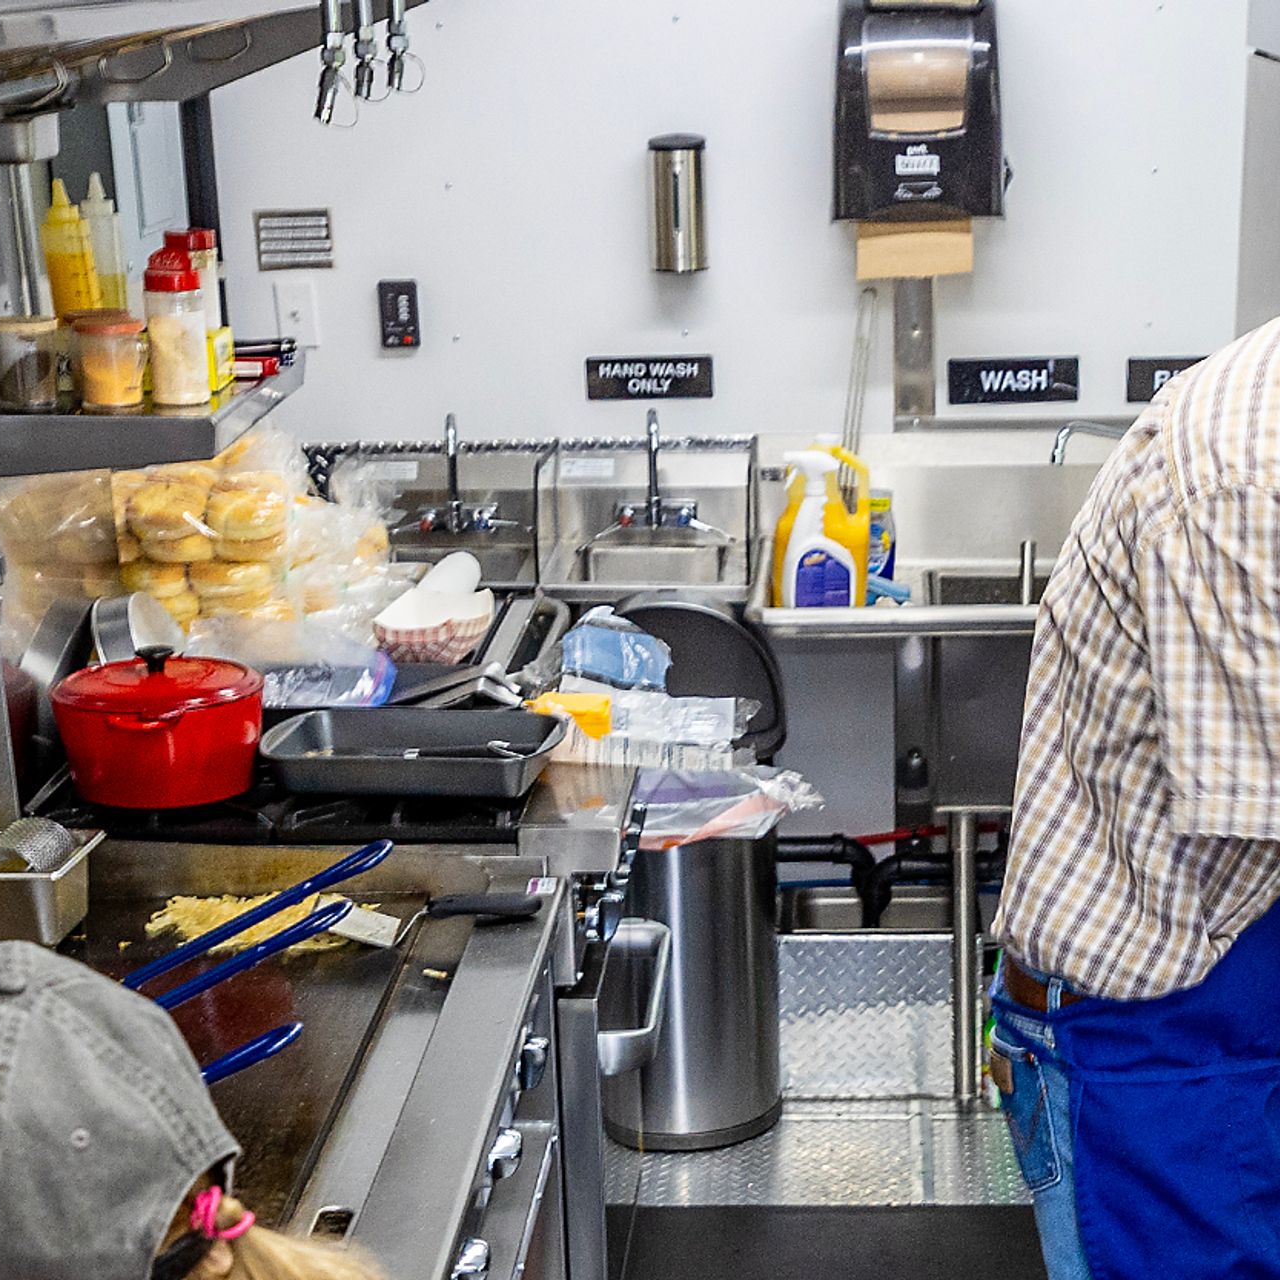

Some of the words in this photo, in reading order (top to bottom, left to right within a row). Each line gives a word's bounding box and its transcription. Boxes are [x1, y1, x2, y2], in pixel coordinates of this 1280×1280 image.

[599, 362, 647, 378] HAND
[649, 362, 699, 378] WASH
[627, 378, 672, 394] ONLY
[980, 370, 1048, 392] WASH
